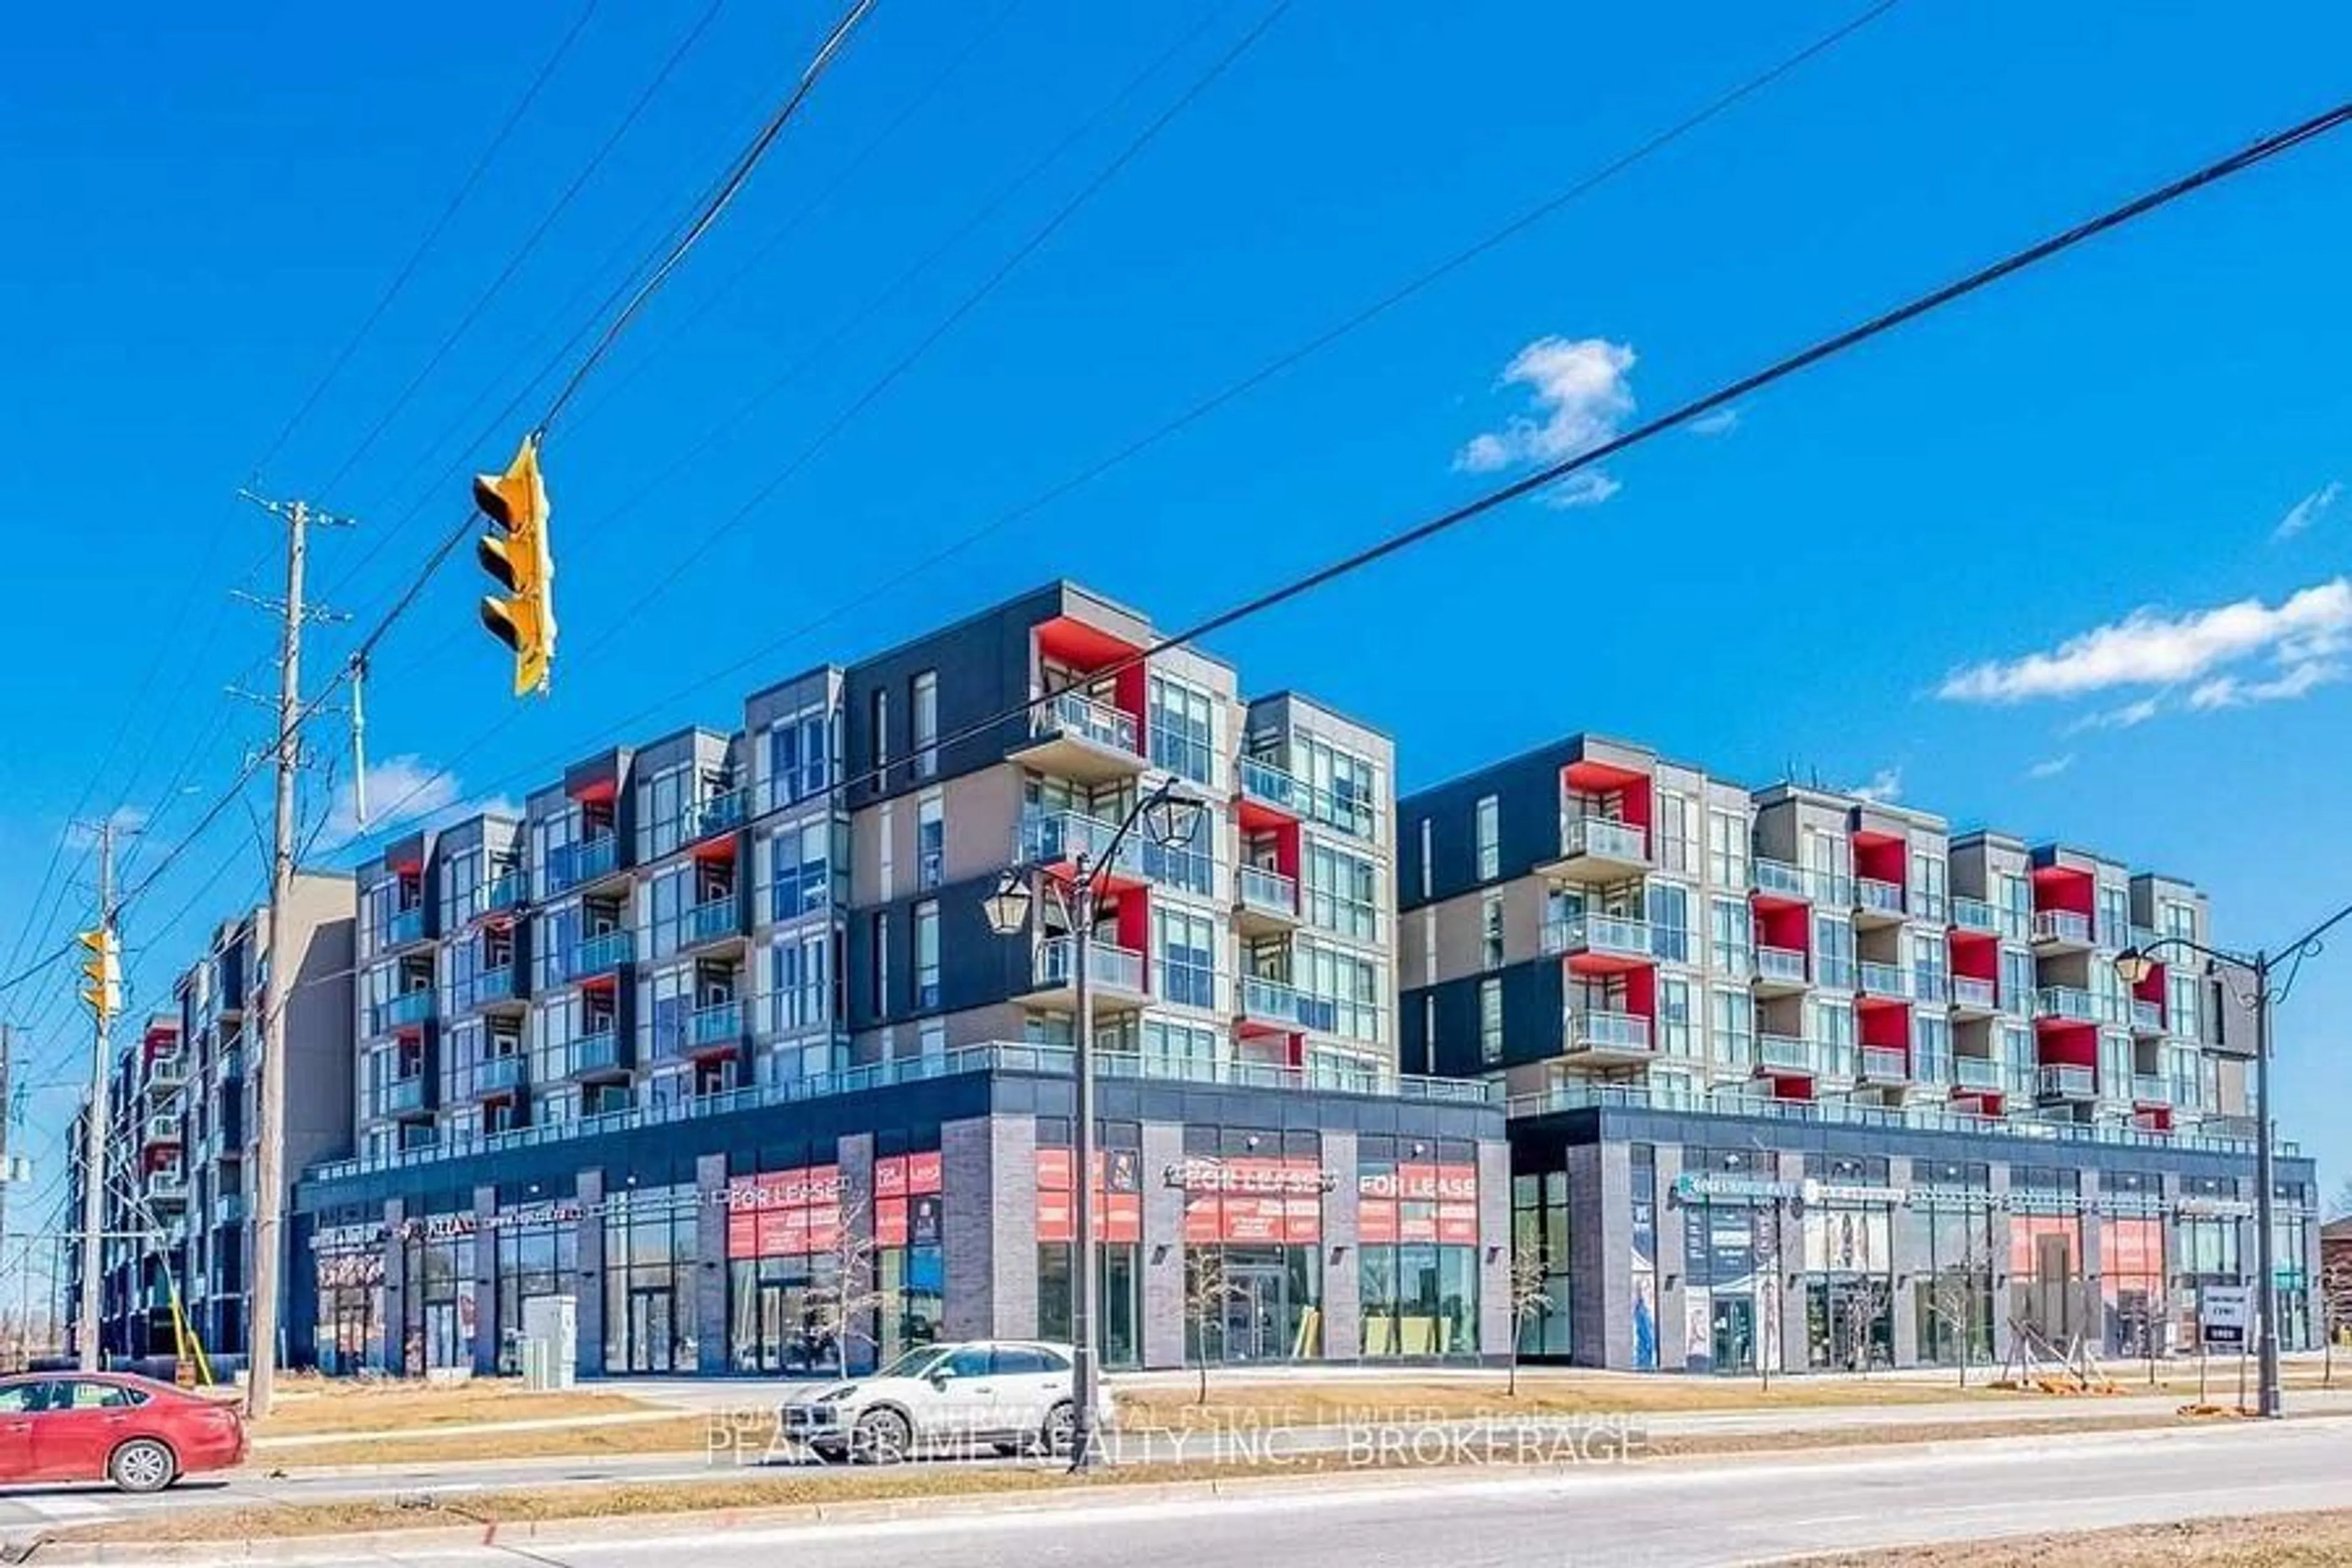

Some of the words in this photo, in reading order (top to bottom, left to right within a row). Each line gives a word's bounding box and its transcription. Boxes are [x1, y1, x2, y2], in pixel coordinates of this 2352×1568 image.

[731, 1186, 774, 1210] FOR
[1359, 1175, 1405, 1197] FOR
[1411, 1178, 1476, 1199] LEASE
